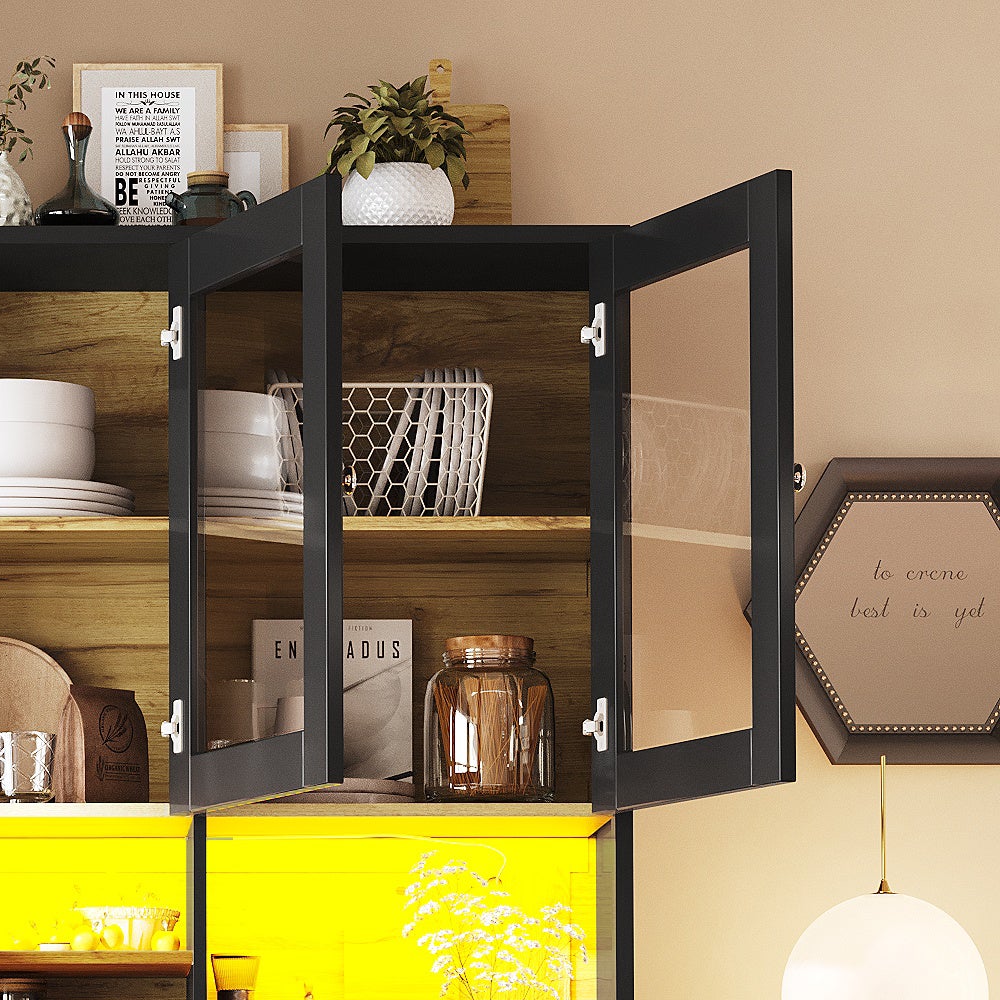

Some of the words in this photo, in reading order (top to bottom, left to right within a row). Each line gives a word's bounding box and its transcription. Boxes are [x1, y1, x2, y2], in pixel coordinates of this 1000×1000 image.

[115, 91, 125, 99] IN
[128, 91, 148, 99] THIS
[150, 91, 180, 99] HOUSE
[115, 178, 139, 206] BE
[873, 559, 895, 580] to
[850, 597, 890, 618] best
[913, 603, 931, 618] is
[954, 597, 986, 629] yet
